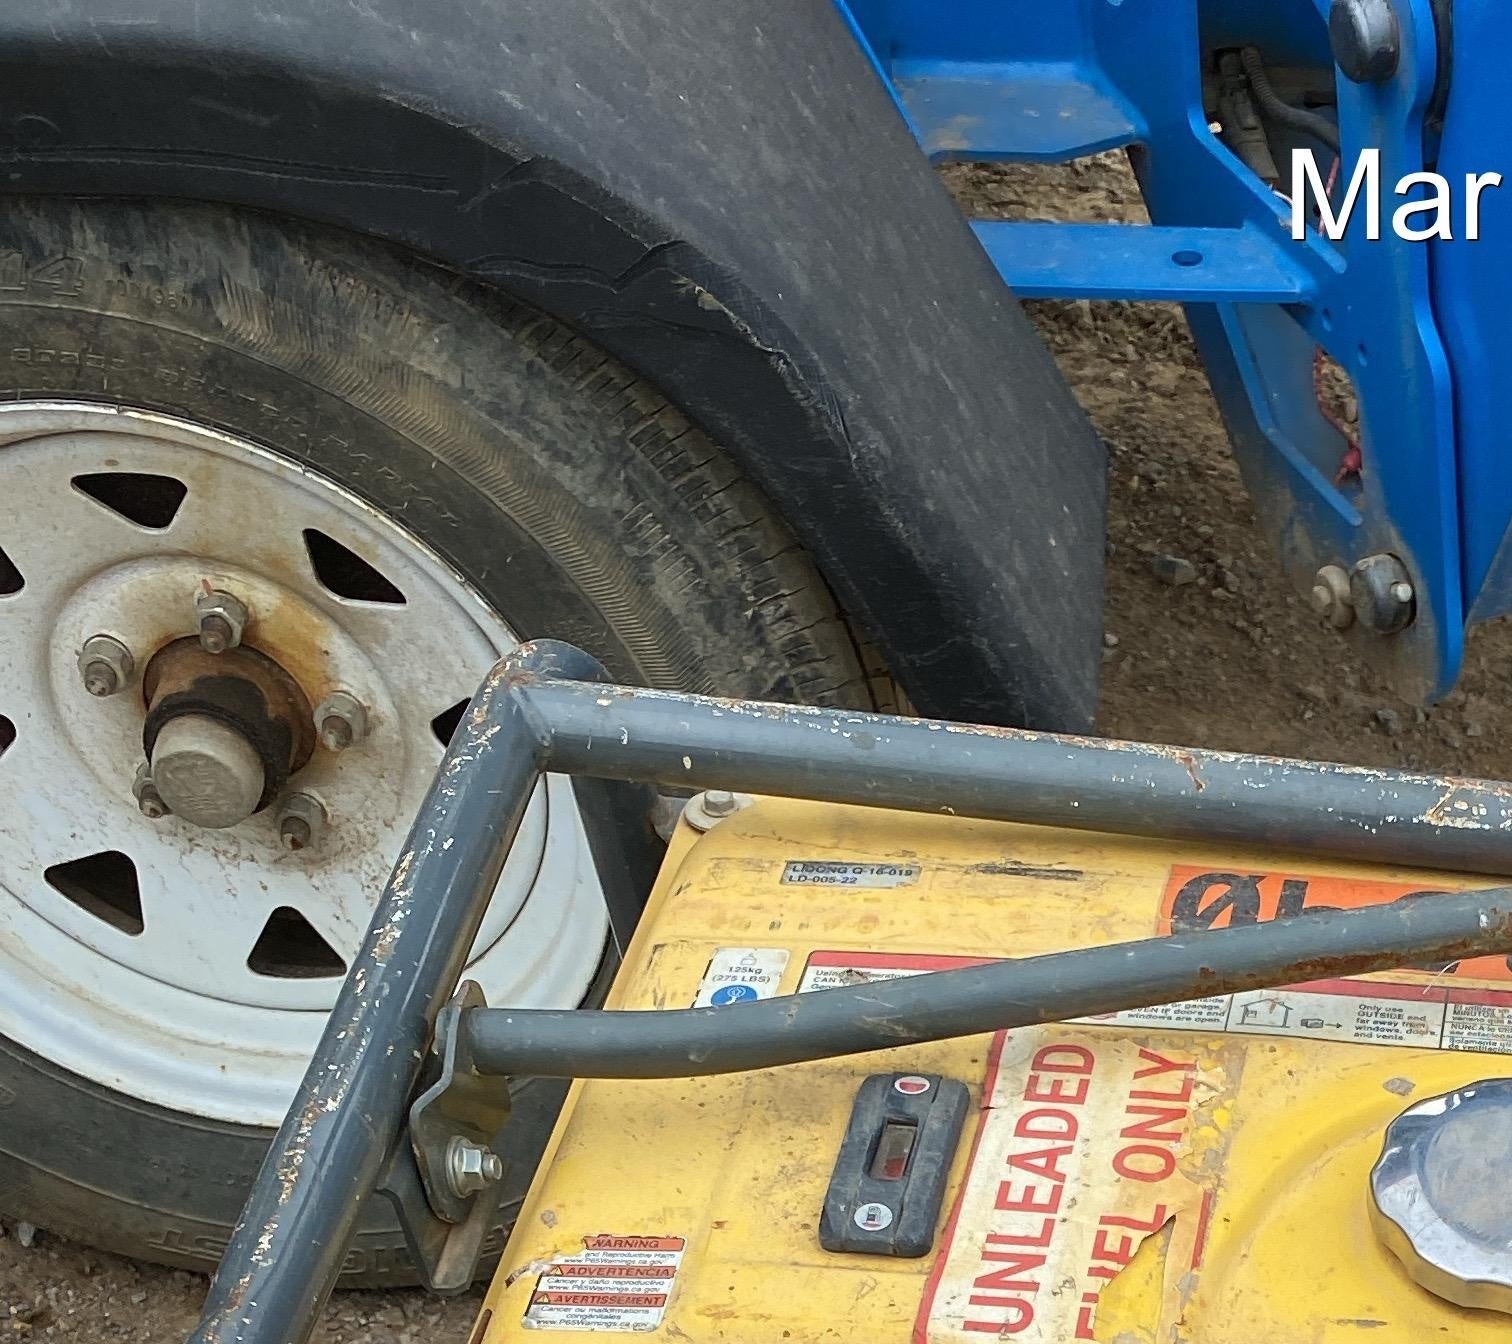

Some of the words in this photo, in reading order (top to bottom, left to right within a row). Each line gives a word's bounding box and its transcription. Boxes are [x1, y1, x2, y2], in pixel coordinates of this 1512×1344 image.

[728, 965, 764, 976] 125kg
[711, 974, 736, 983] (275
[739, 975, 771, 985] LBS)
[1357, 1003, 1382, 1014] Only
[1357, 1010, 1405, 1020] OUTSIDE
[1112, 1047, 1198, 1184] ONLY
[963, 1043, 1095, 1335] UNLEADED
[566, 1266, 671, 1278] ADVERTENCIA
[555, 1294, 663, 1306] AVERTISSEMENT
